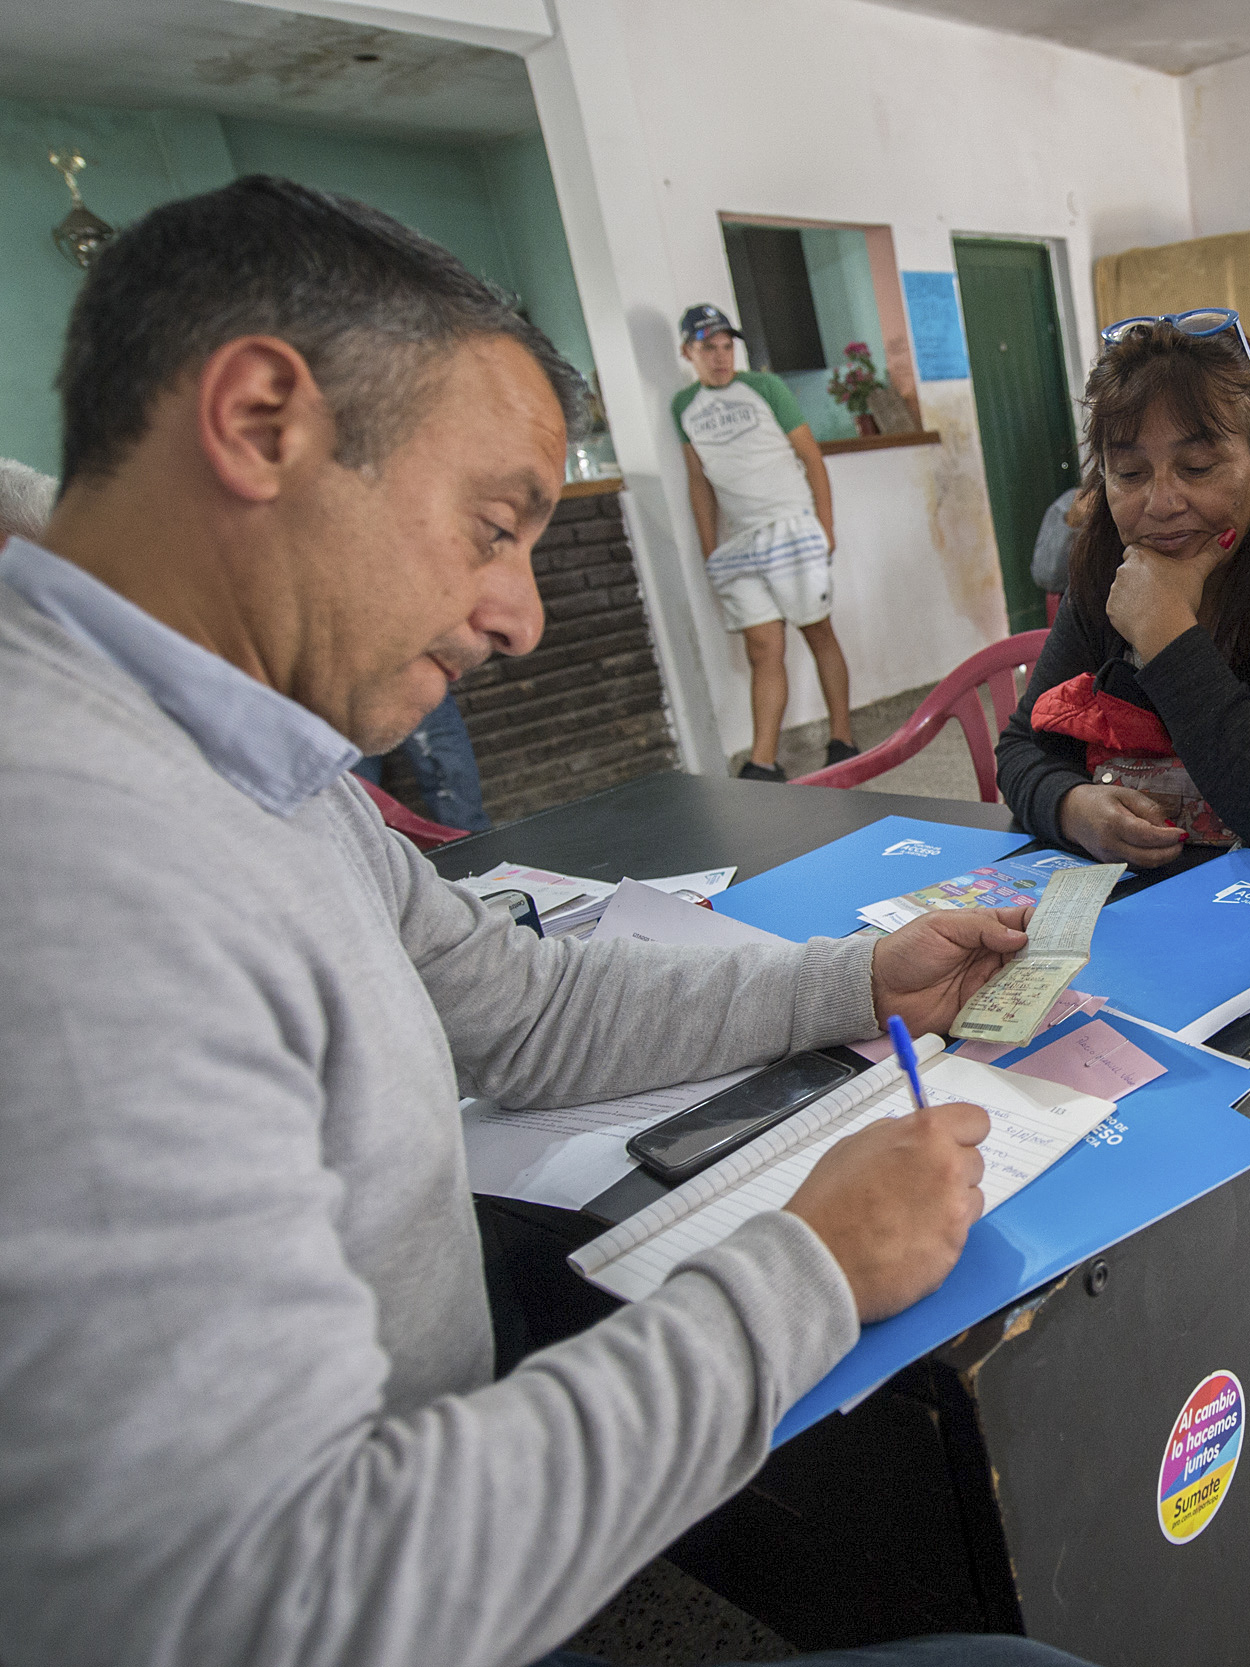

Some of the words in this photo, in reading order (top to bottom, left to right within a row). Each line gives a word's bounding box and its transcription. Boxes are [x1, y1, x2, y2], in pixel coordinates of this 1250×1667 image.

[1091, 1123, 1123, 1145] ESO
[1114, 1122, 1129, 1133] DE
[1179, 1408, 1193, 1434] Al
[1195, 1389, 1237, 1424] cambio
[1171, 1439, 1183, 1461] lo
[1186, 1411, 1237, 1453] hacemos
[1183, 1443, 1220, 1481] juntos
[1174, 1477, 1221, 1519] Sumate
